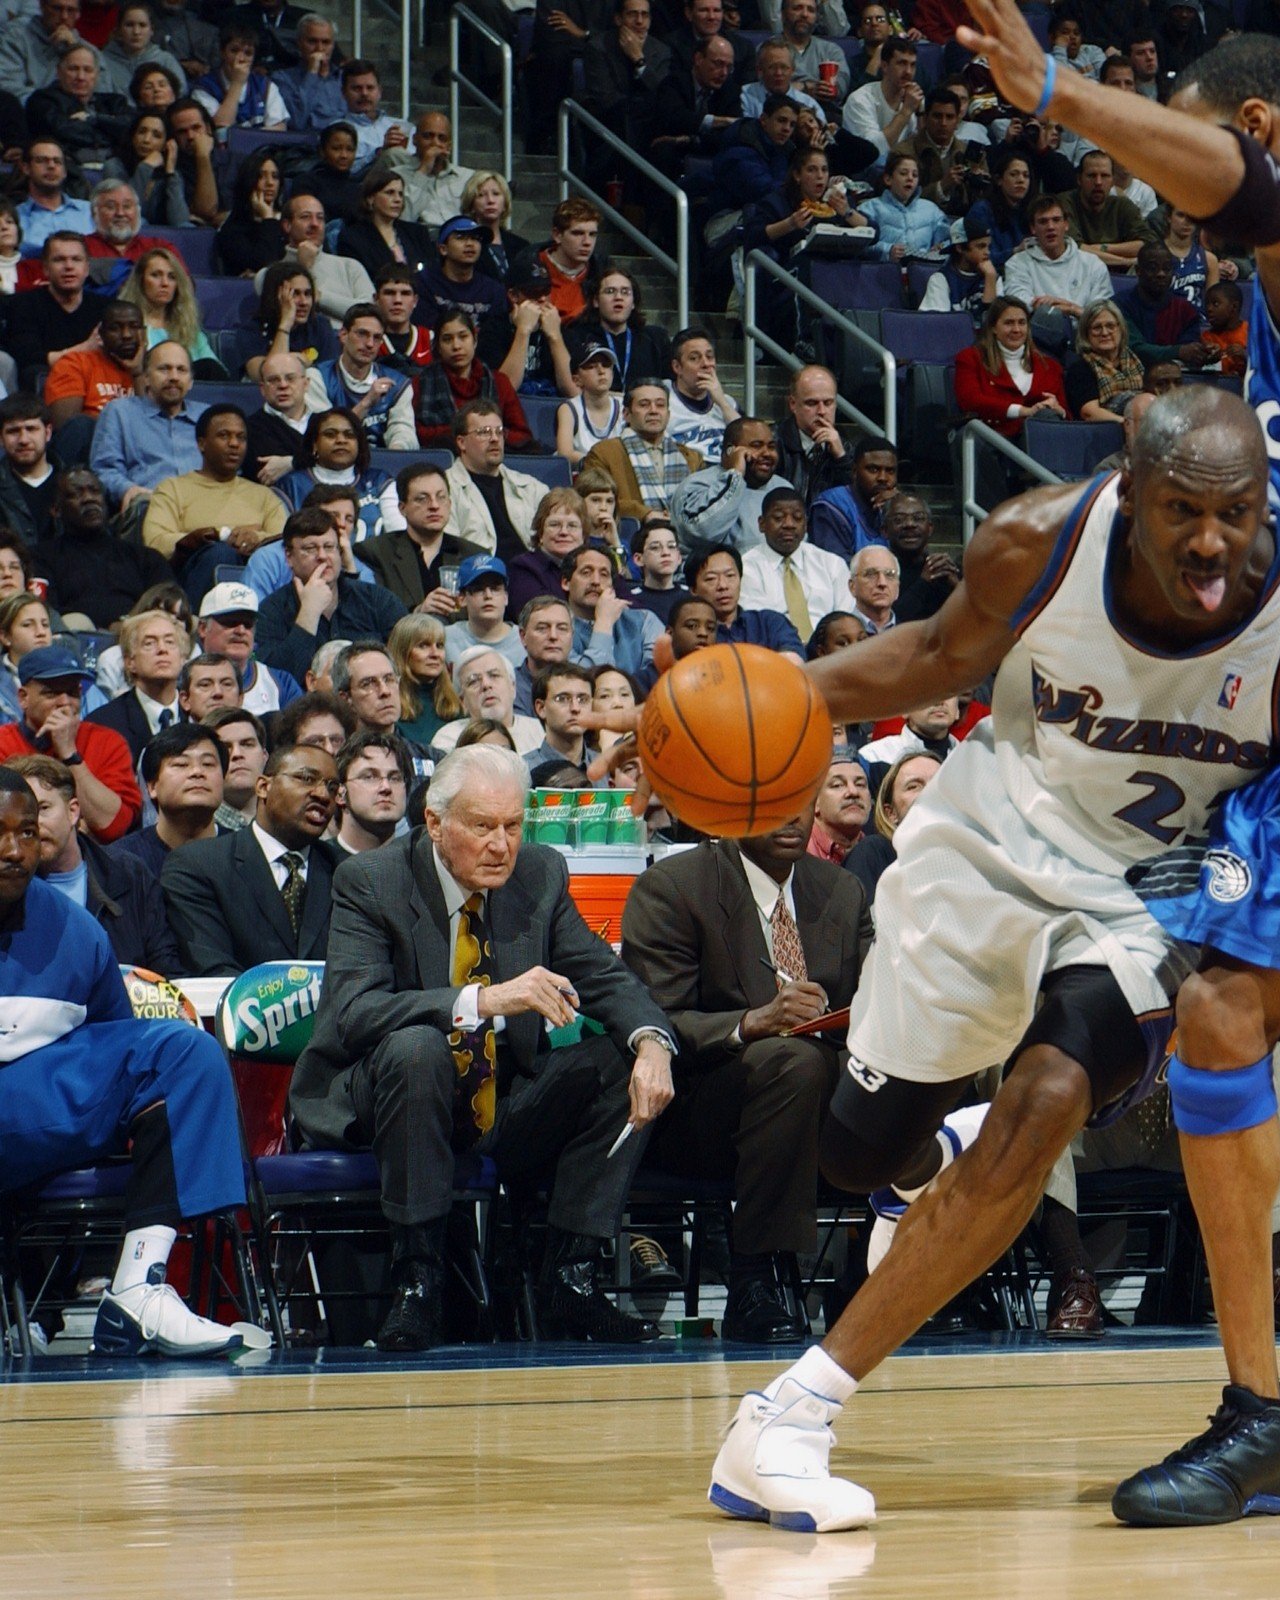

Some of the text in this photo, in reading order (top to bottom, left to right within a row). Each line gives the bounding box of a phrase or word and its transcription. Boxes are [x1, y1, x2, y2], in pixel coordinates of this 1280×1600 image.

[1112, 769, 1228, 846] 2
[130, 981, 183, 1004] OBEY
[257, 978, 284, 999] Enjoy
[133, 1003, 179, 1019] YOUR
[237, 972, 323, 1052] Sprit
